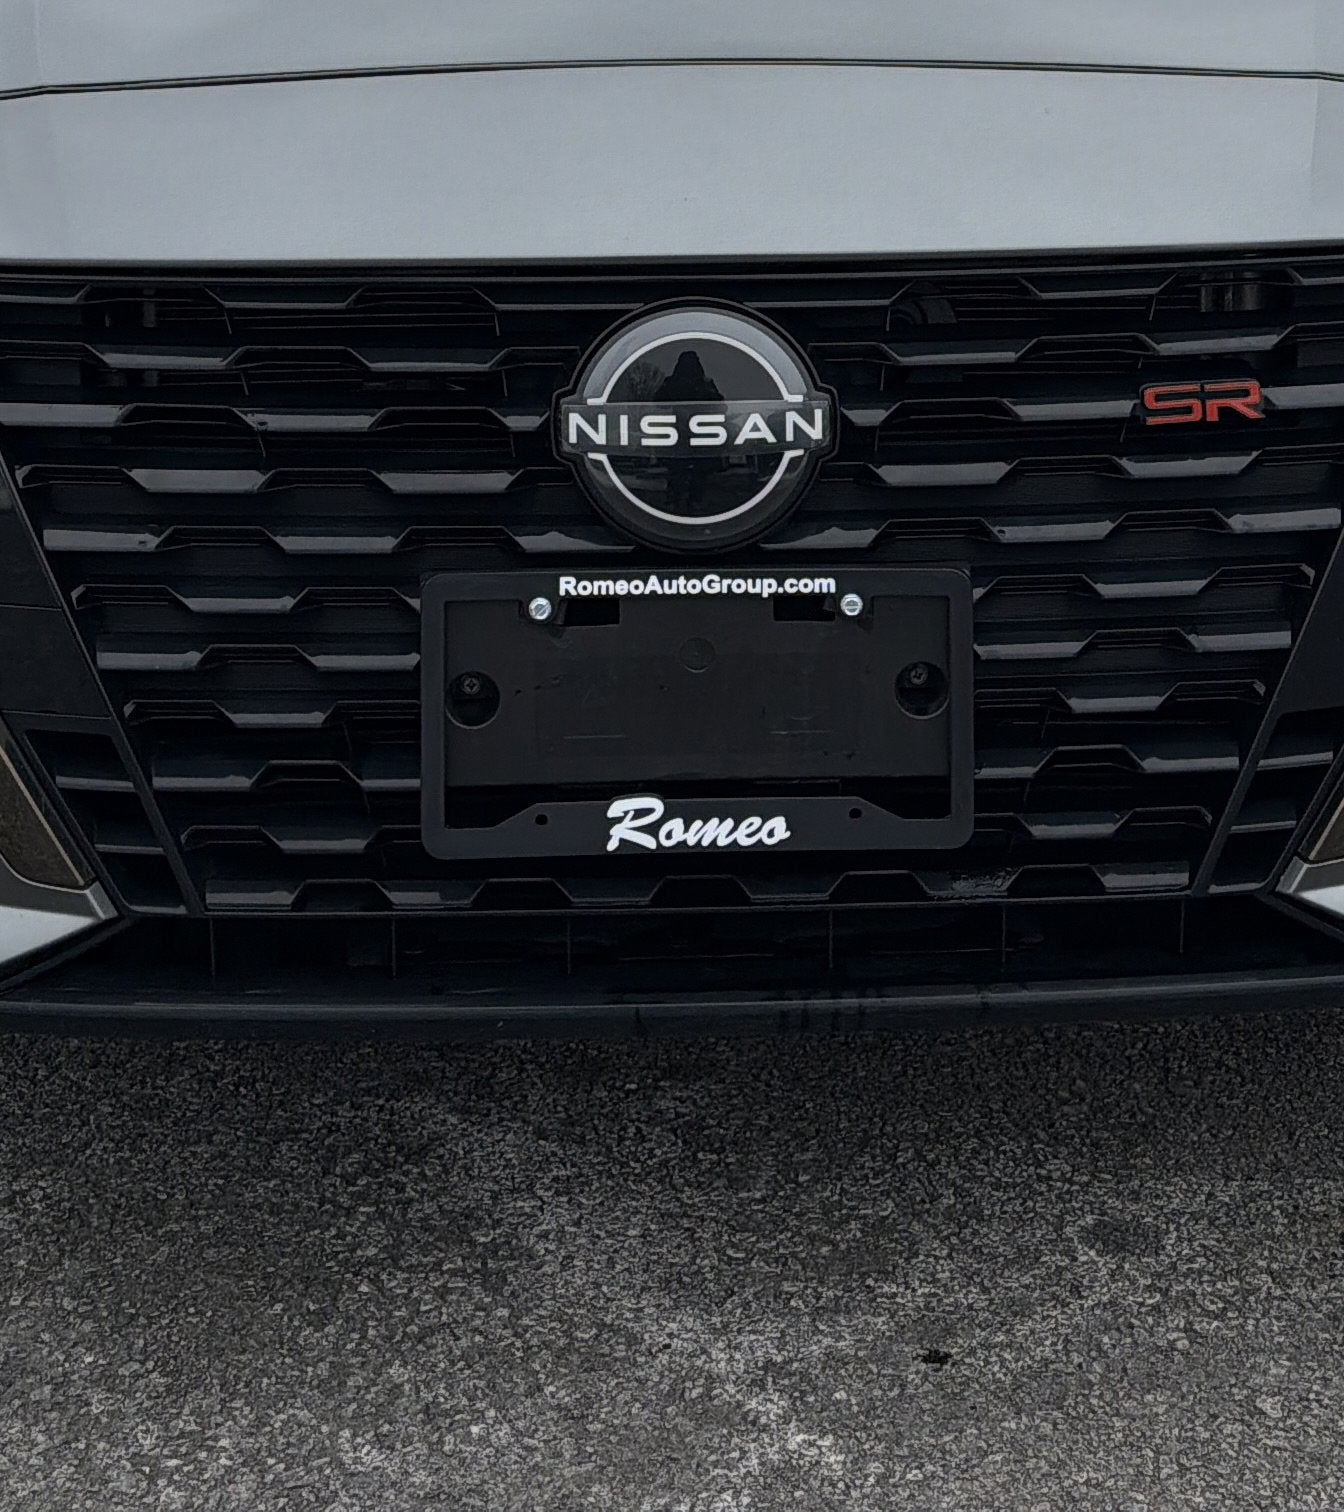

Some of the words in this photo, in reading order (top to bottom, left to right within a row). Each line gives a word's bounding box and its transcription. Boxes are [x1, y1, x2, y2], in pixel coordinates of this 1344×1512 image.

[1143, 380, 1267, 426] SR
[568, 408, 823, 446] NISSAN
[559, 574, 836, 598] RomeoAutoGroup.com
[606, 796, 791, 852] Romeo
